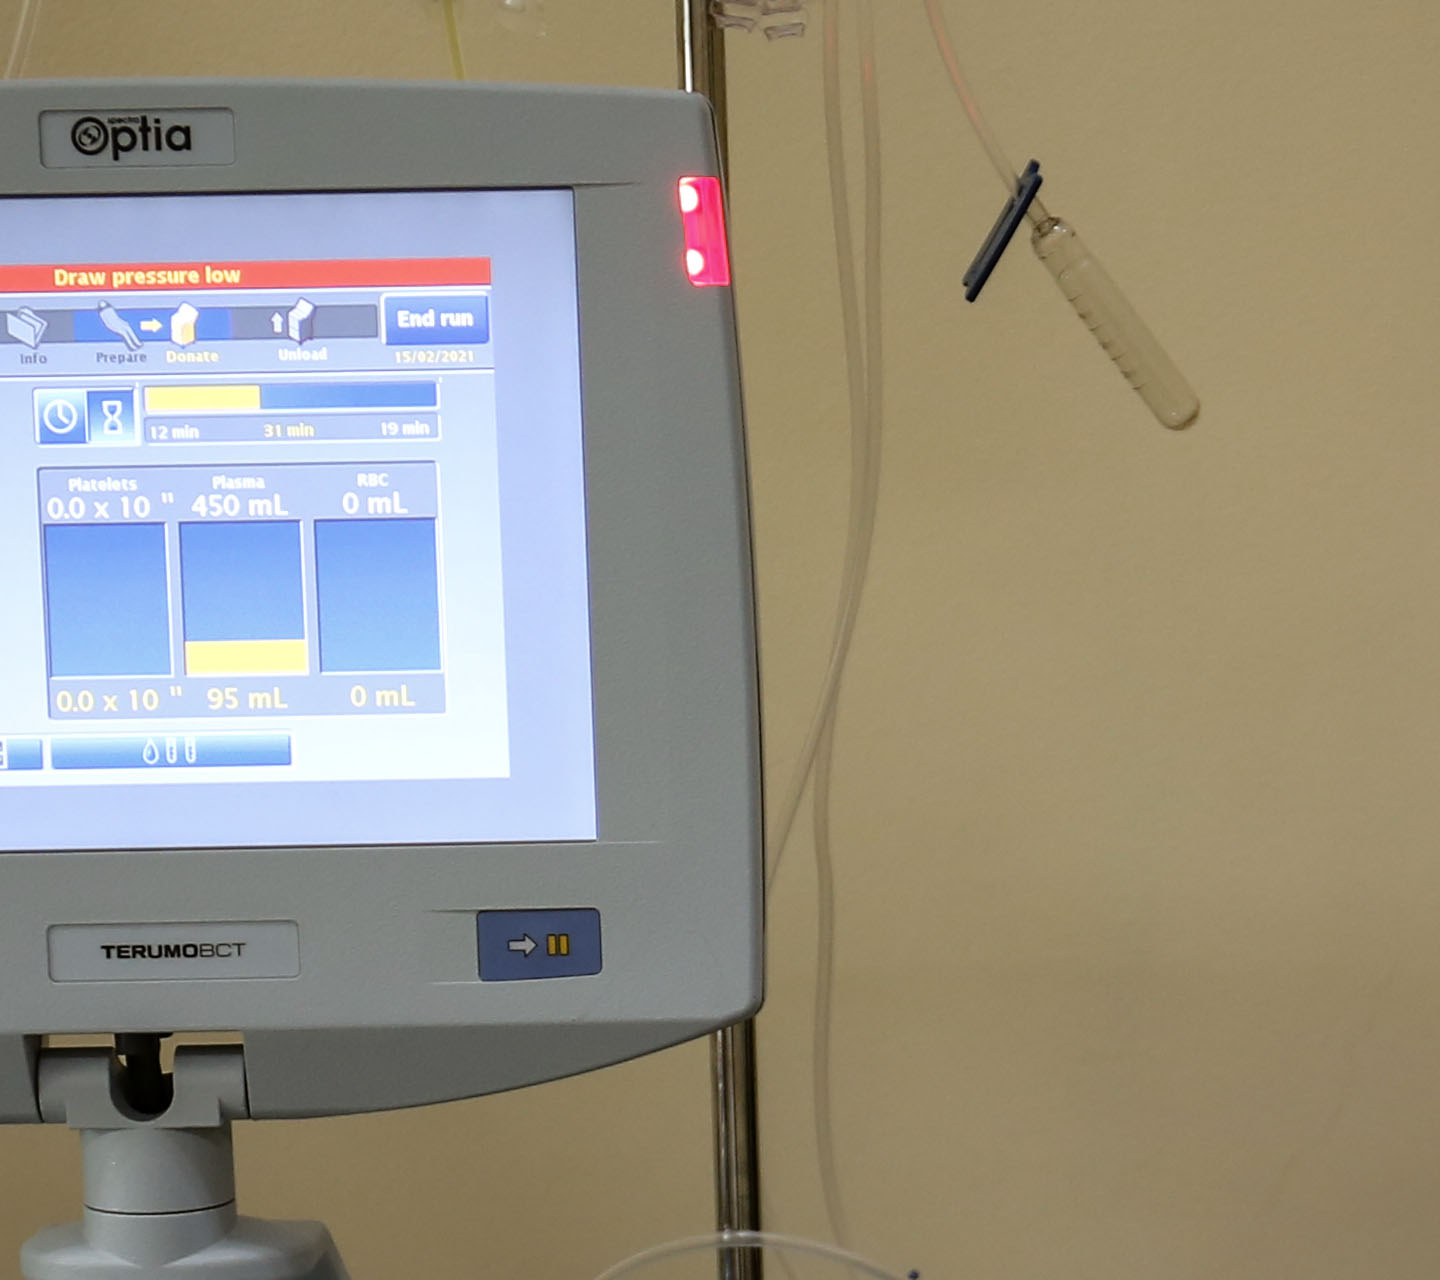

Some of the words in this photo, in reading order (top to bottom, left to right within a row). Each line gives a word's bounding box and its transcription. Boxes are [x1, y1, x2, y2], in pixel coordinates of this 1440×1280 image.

[71, 115, 191, 161] Optia
[54, 269, 105, 286] Draw
[112, 268, 199, 288] pressure
[206, 266, 240, 284] low
[397, 310, 435, 328] End
[441, 311, 473, 327] run
[20, 353, 48, 366] Info
[96, 351, 147, 366] Prepare
[166, 350, 219, 363] Donate
[278, 348, 328, 362] Unload
[395, 349, 474, 364] 15/02/2021
[150, 426, 169, 440] 12
[171, 425, 200, 439] min
[264, 424, 282, 438] 31
[287, 423, 315, 437] min
[381, 422, 399, 436] 19
[402, 421, 430, 435] min
[68, 477, 138, 492] Platelets
[212, 475, 265, 490] Plasma
[357, 473, 389, 487] RBC
[47, 497, 85, 520] 0.0
[93, 502, 110, 519] x
[191, 494, 240, 517] 450
[248, 493, 288, 516] mL
[342, 492, 359, 515] 0
[368, 491, 408, 514] mL
[56, 690, 94, 713] 0.0
[102, 695, 118, 711] x
[207, 687, 239, 710] 95
[248, 686, 288, 709] mL
[350, 685, 367, 708] 0
[376, 684, 415, 707] mL
